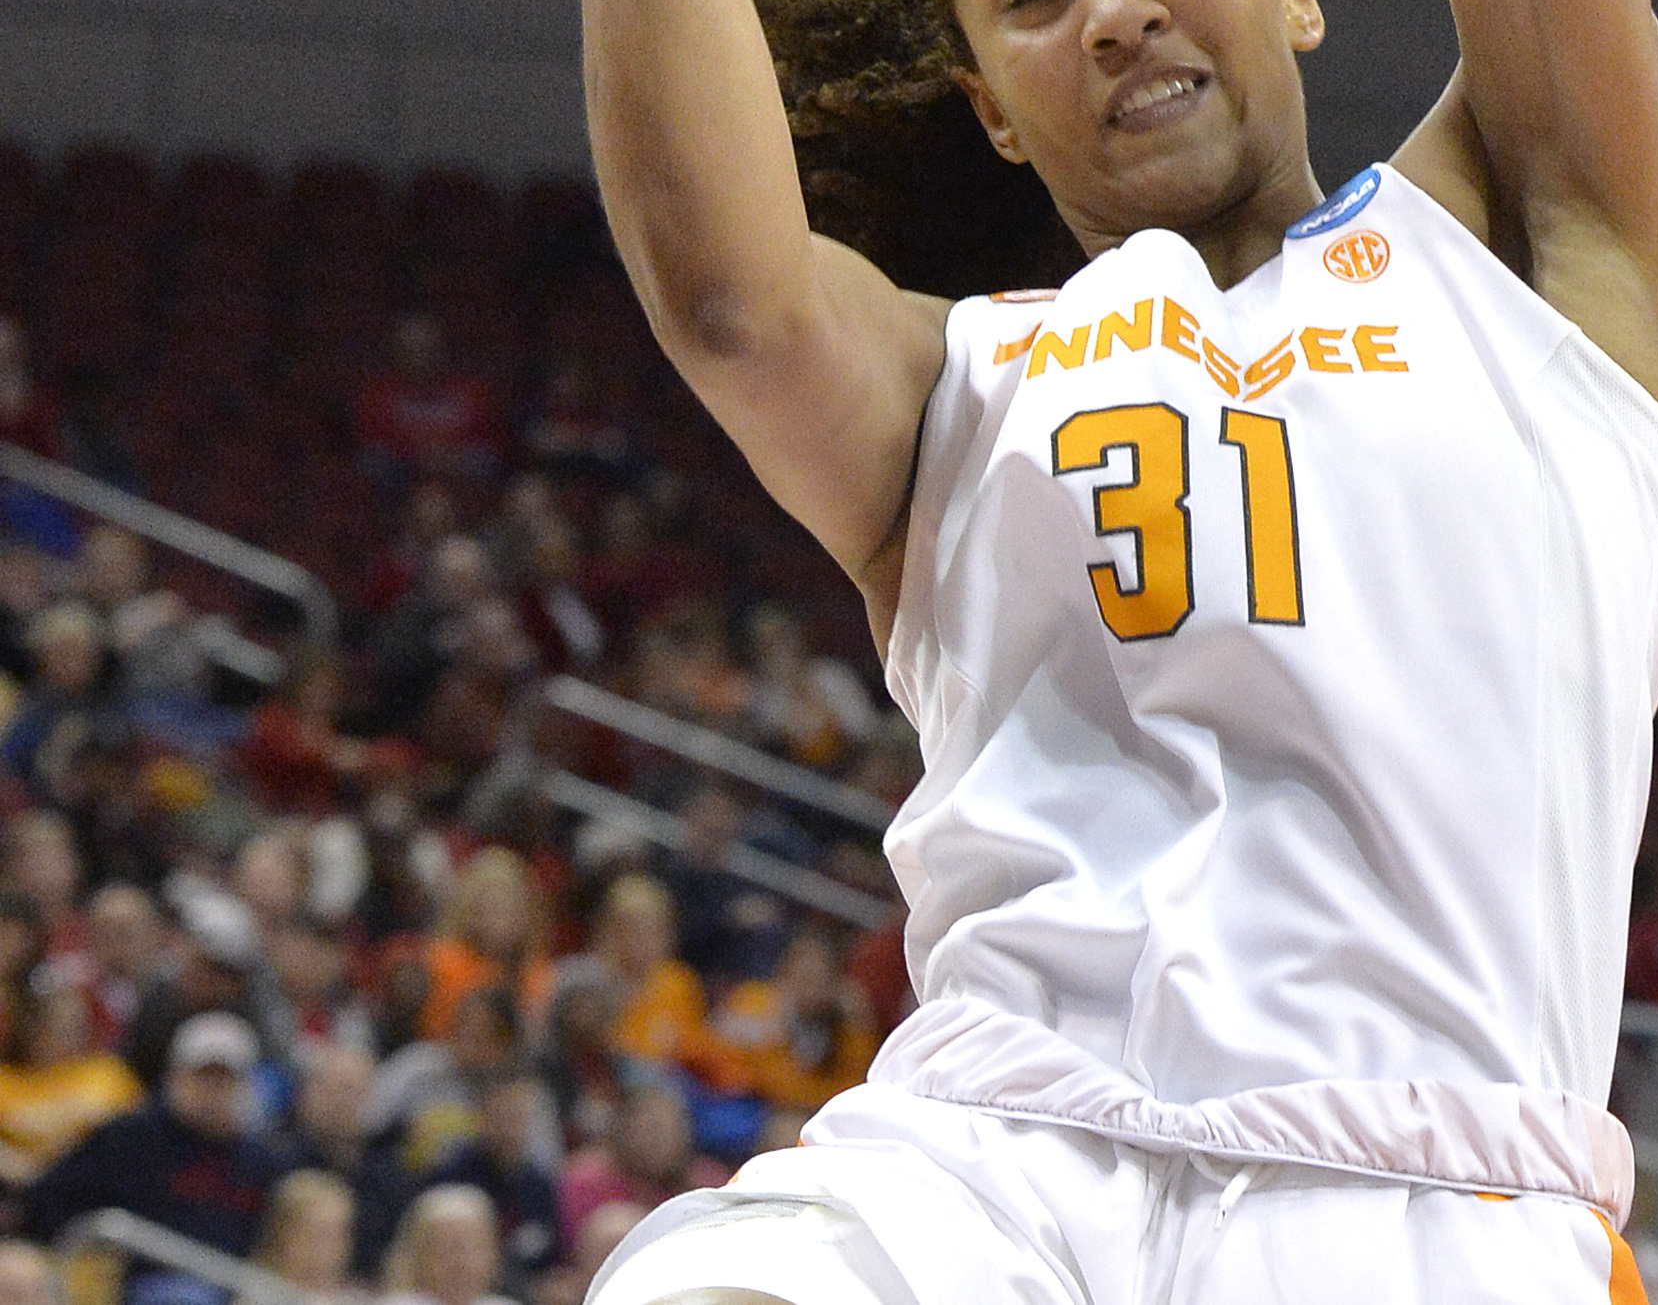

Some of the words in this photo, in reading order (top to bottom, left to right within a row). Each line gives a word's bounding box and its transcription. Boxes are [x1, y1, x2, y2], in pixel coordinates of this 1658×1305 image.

[1300, 177, 1377, 234] NCAA
[1328, 234, 1385, 278] SEC
[1052, 400, 1305, 642] 31
